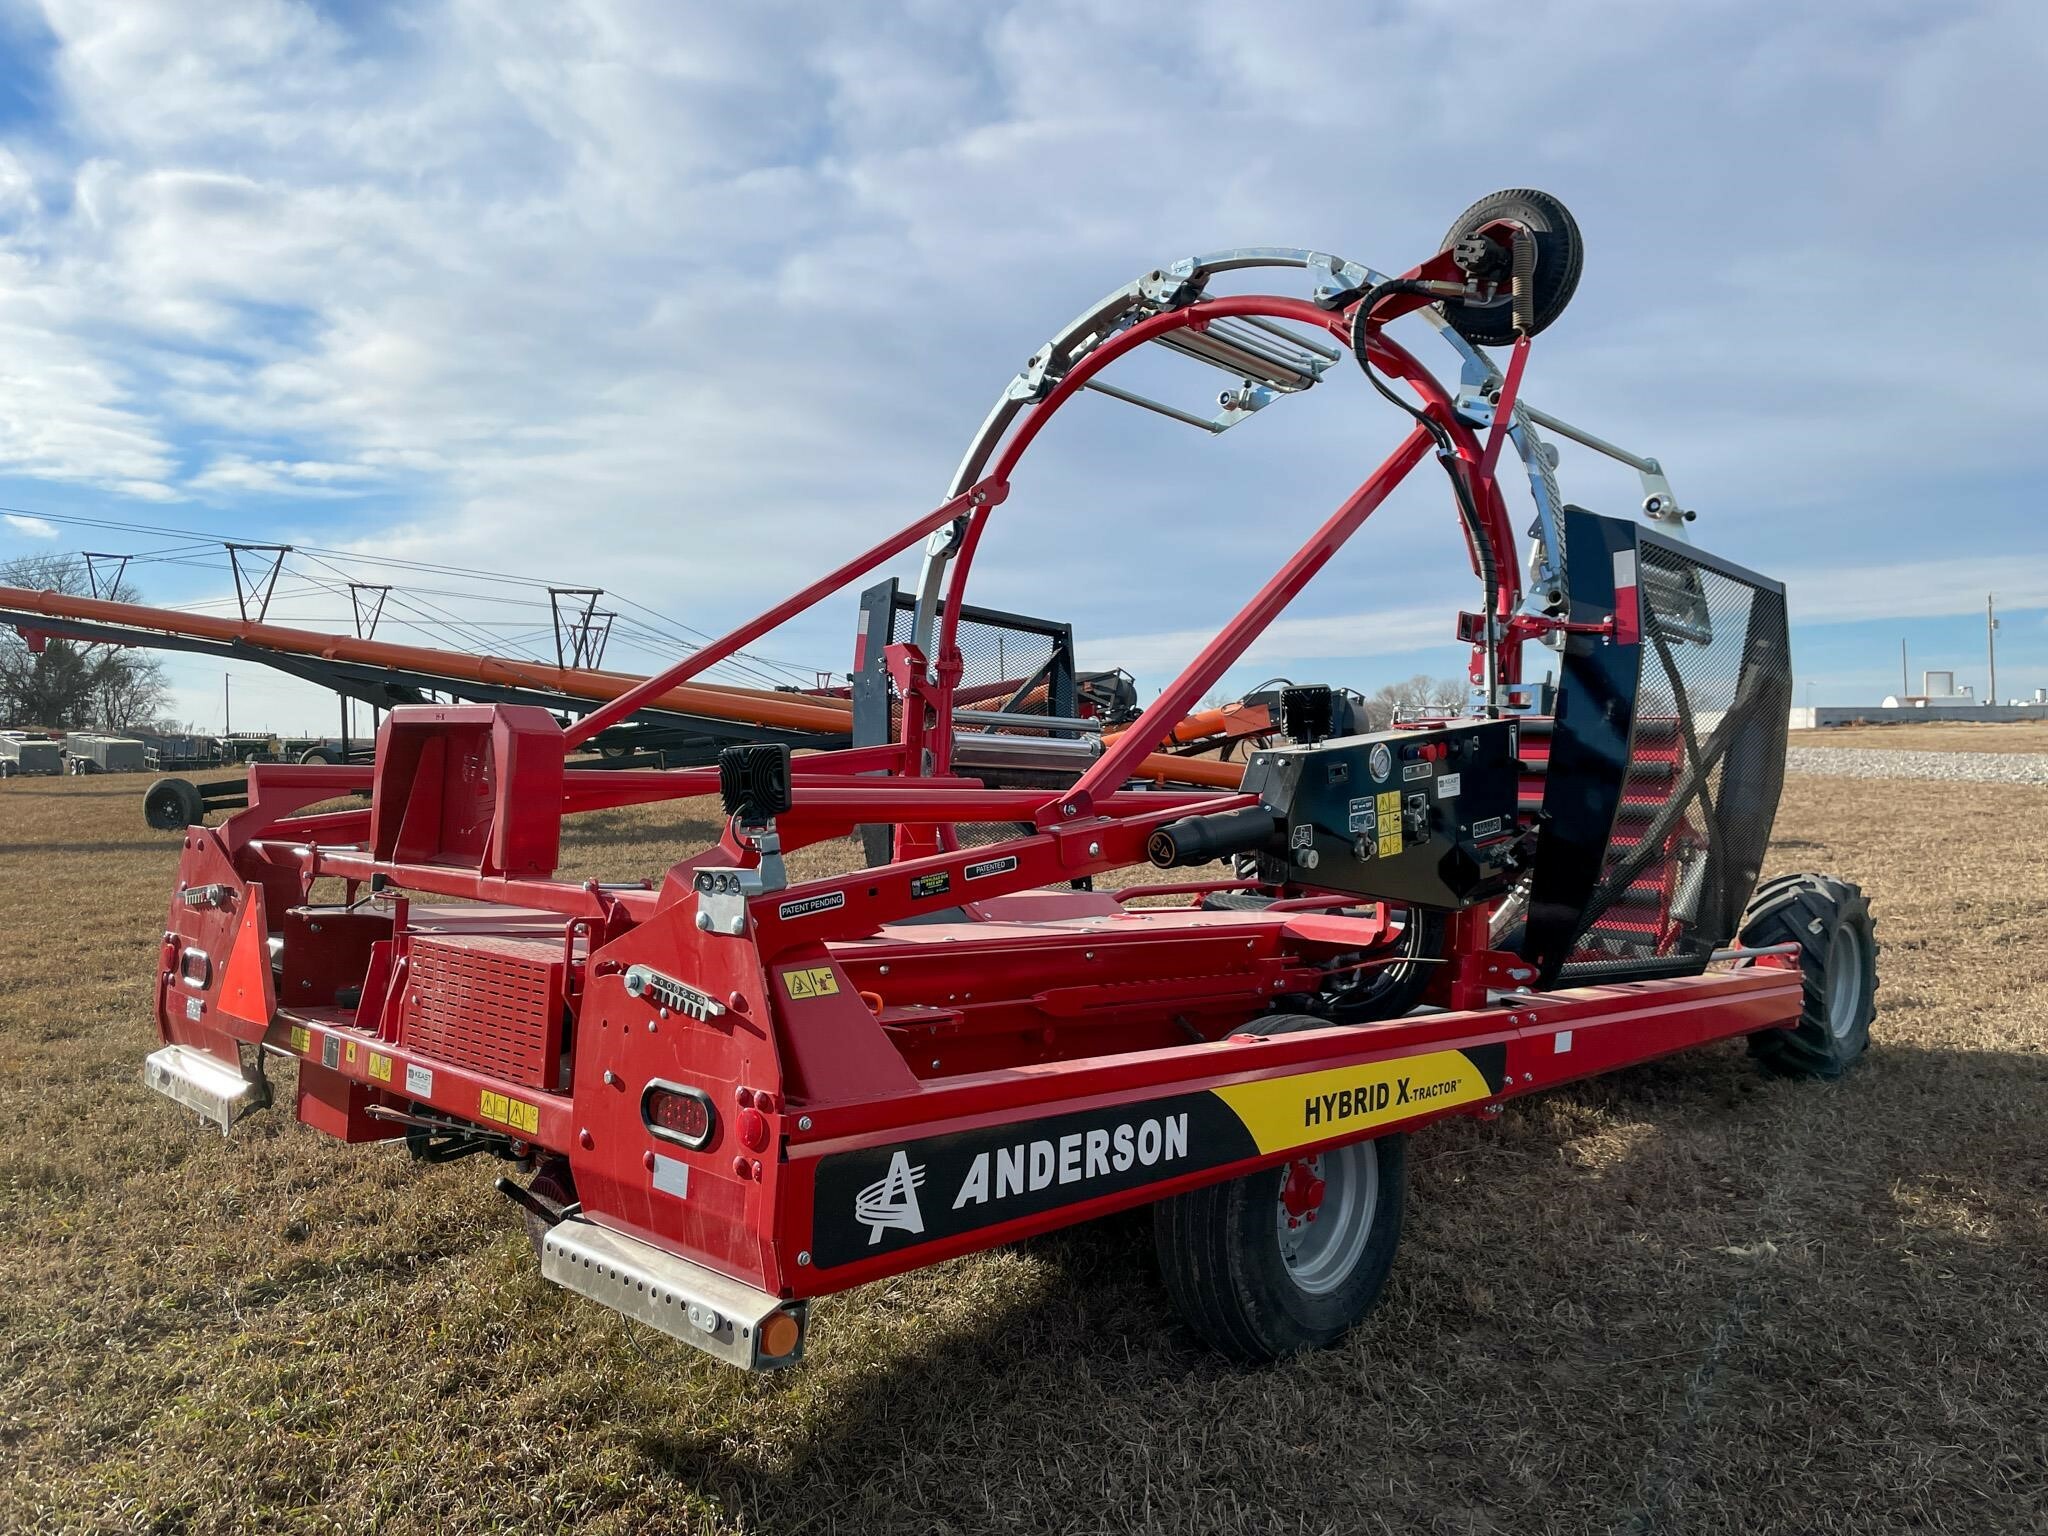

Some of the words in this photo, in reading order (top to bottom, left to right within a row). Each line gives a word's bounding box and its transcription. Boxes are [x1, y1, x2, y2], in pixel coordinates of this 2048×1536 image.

[976, 860, 1006, 875] PATENTED
[781, 902, 810, 916] PATENT
[810, 895, 842, 910] PENDING
[1304, 1083, 1390, 1127] HYBRID
[952, 1112, 1188, 1210] ANDERSON
